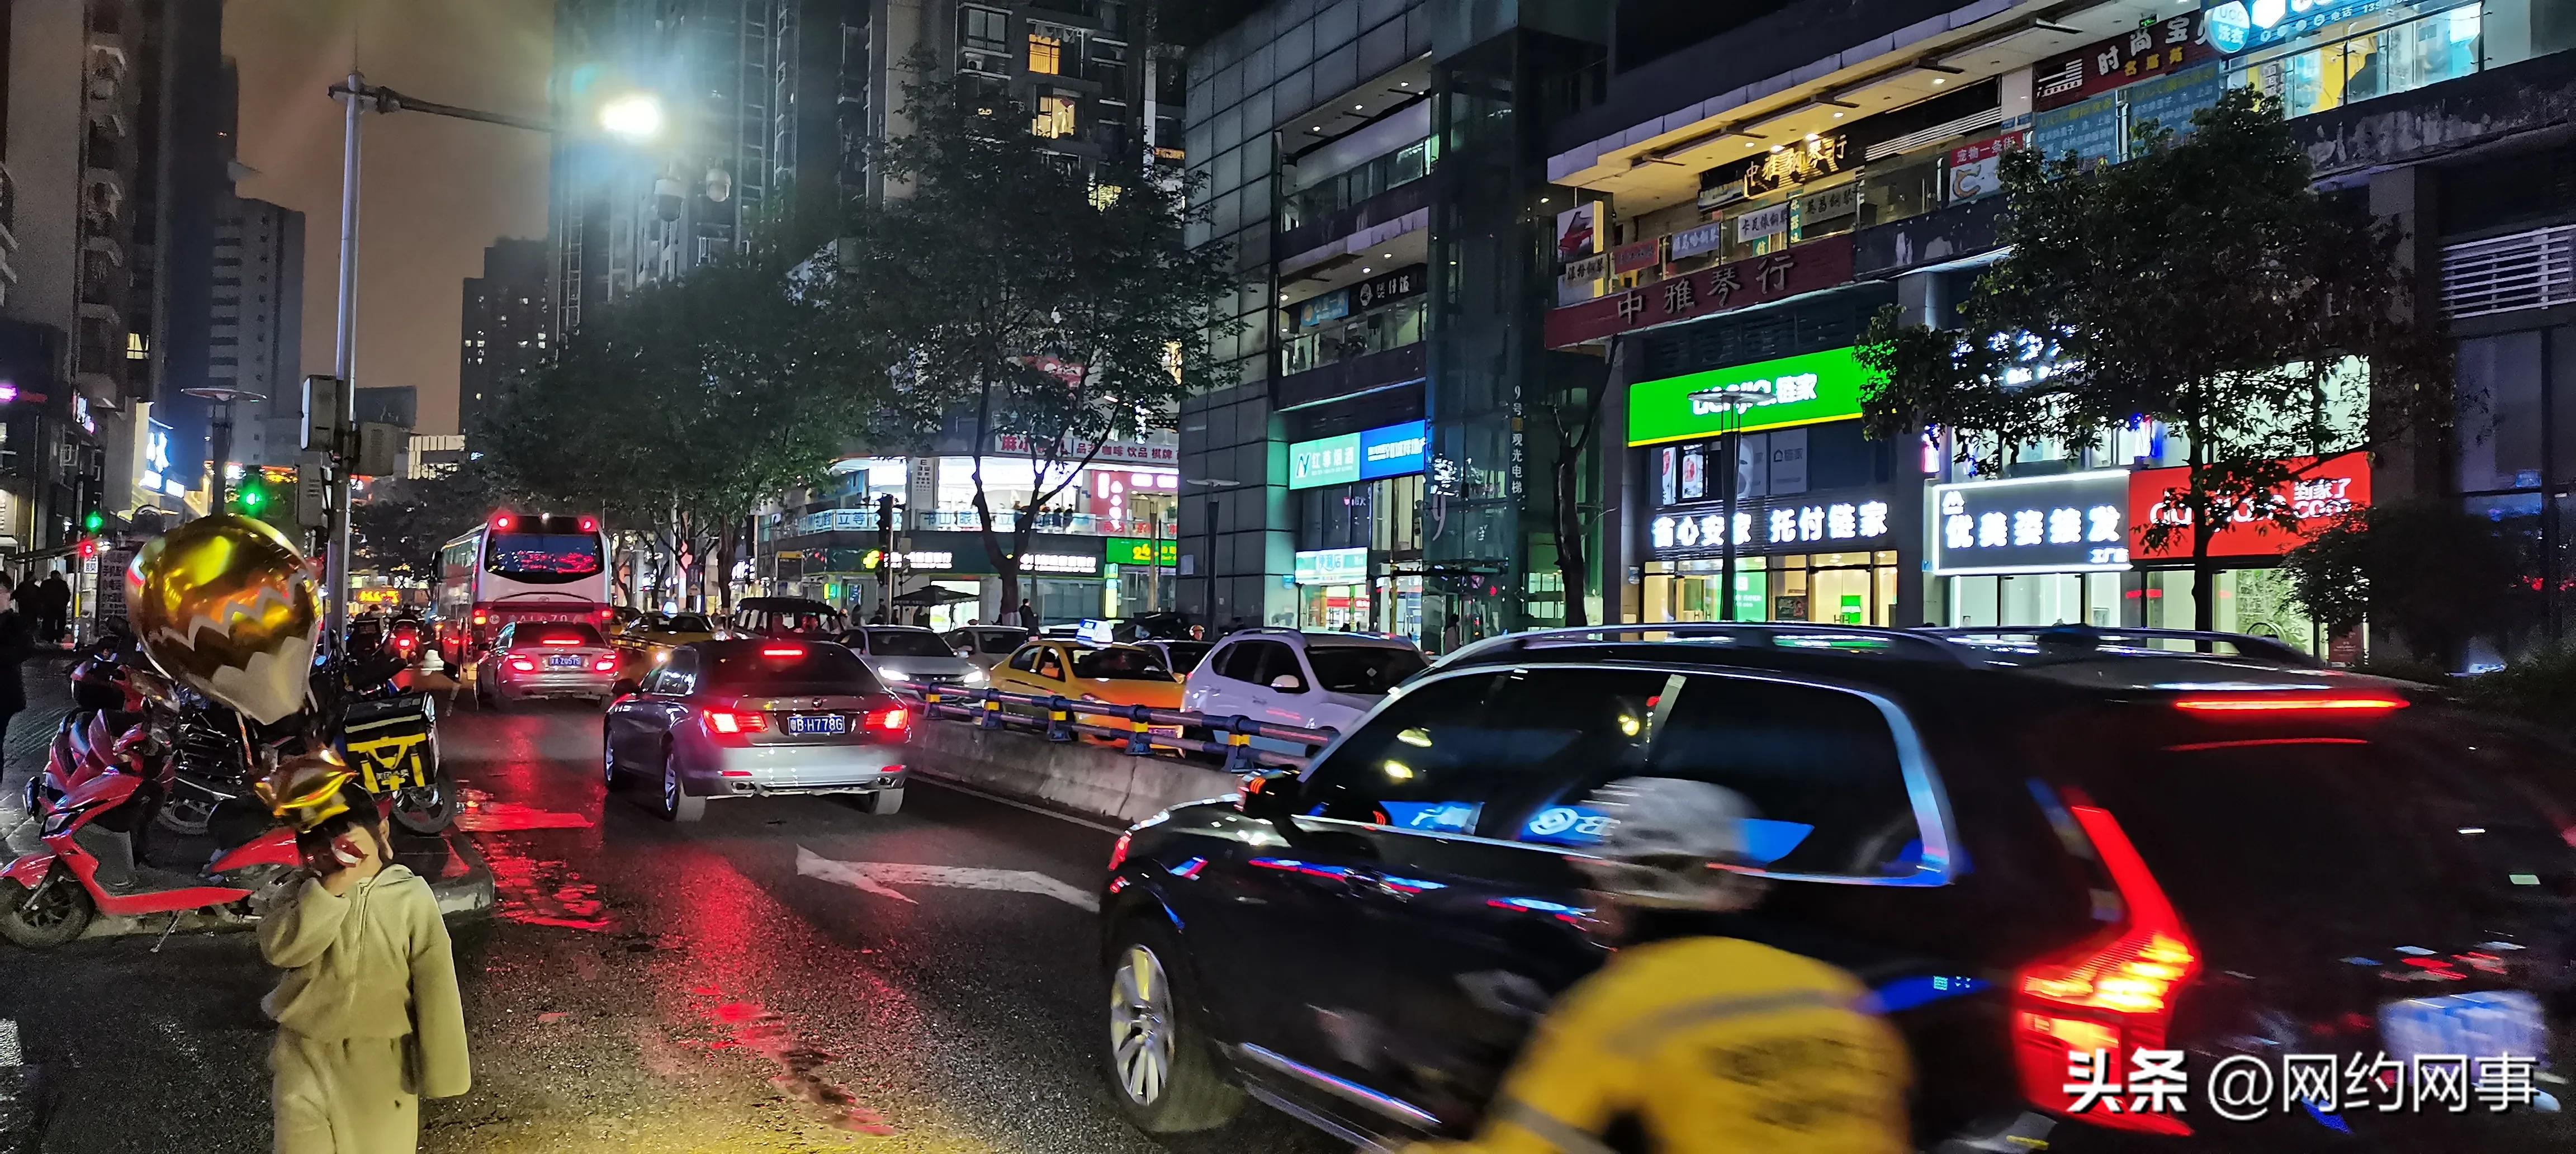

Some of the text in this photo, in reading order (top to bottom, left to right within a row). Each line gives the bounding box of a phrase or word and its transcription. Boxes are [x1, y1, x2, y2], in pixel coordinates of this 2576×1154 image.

[2219, 8, 2243, 22] UCC
[1618, 254, 1794, 325] 中雅琴行
[1101, 445, 1124, 457] 咖啡
[1127, 447, 1148, 458] 饮品
[1152, 448, 1173, 460] 棋牌
[1512, 385, 1523, 494] 9号 观光电梯
[1770, 500, 1888, 544] 托付链家
[790, 718, 843, 732] B·H778G
